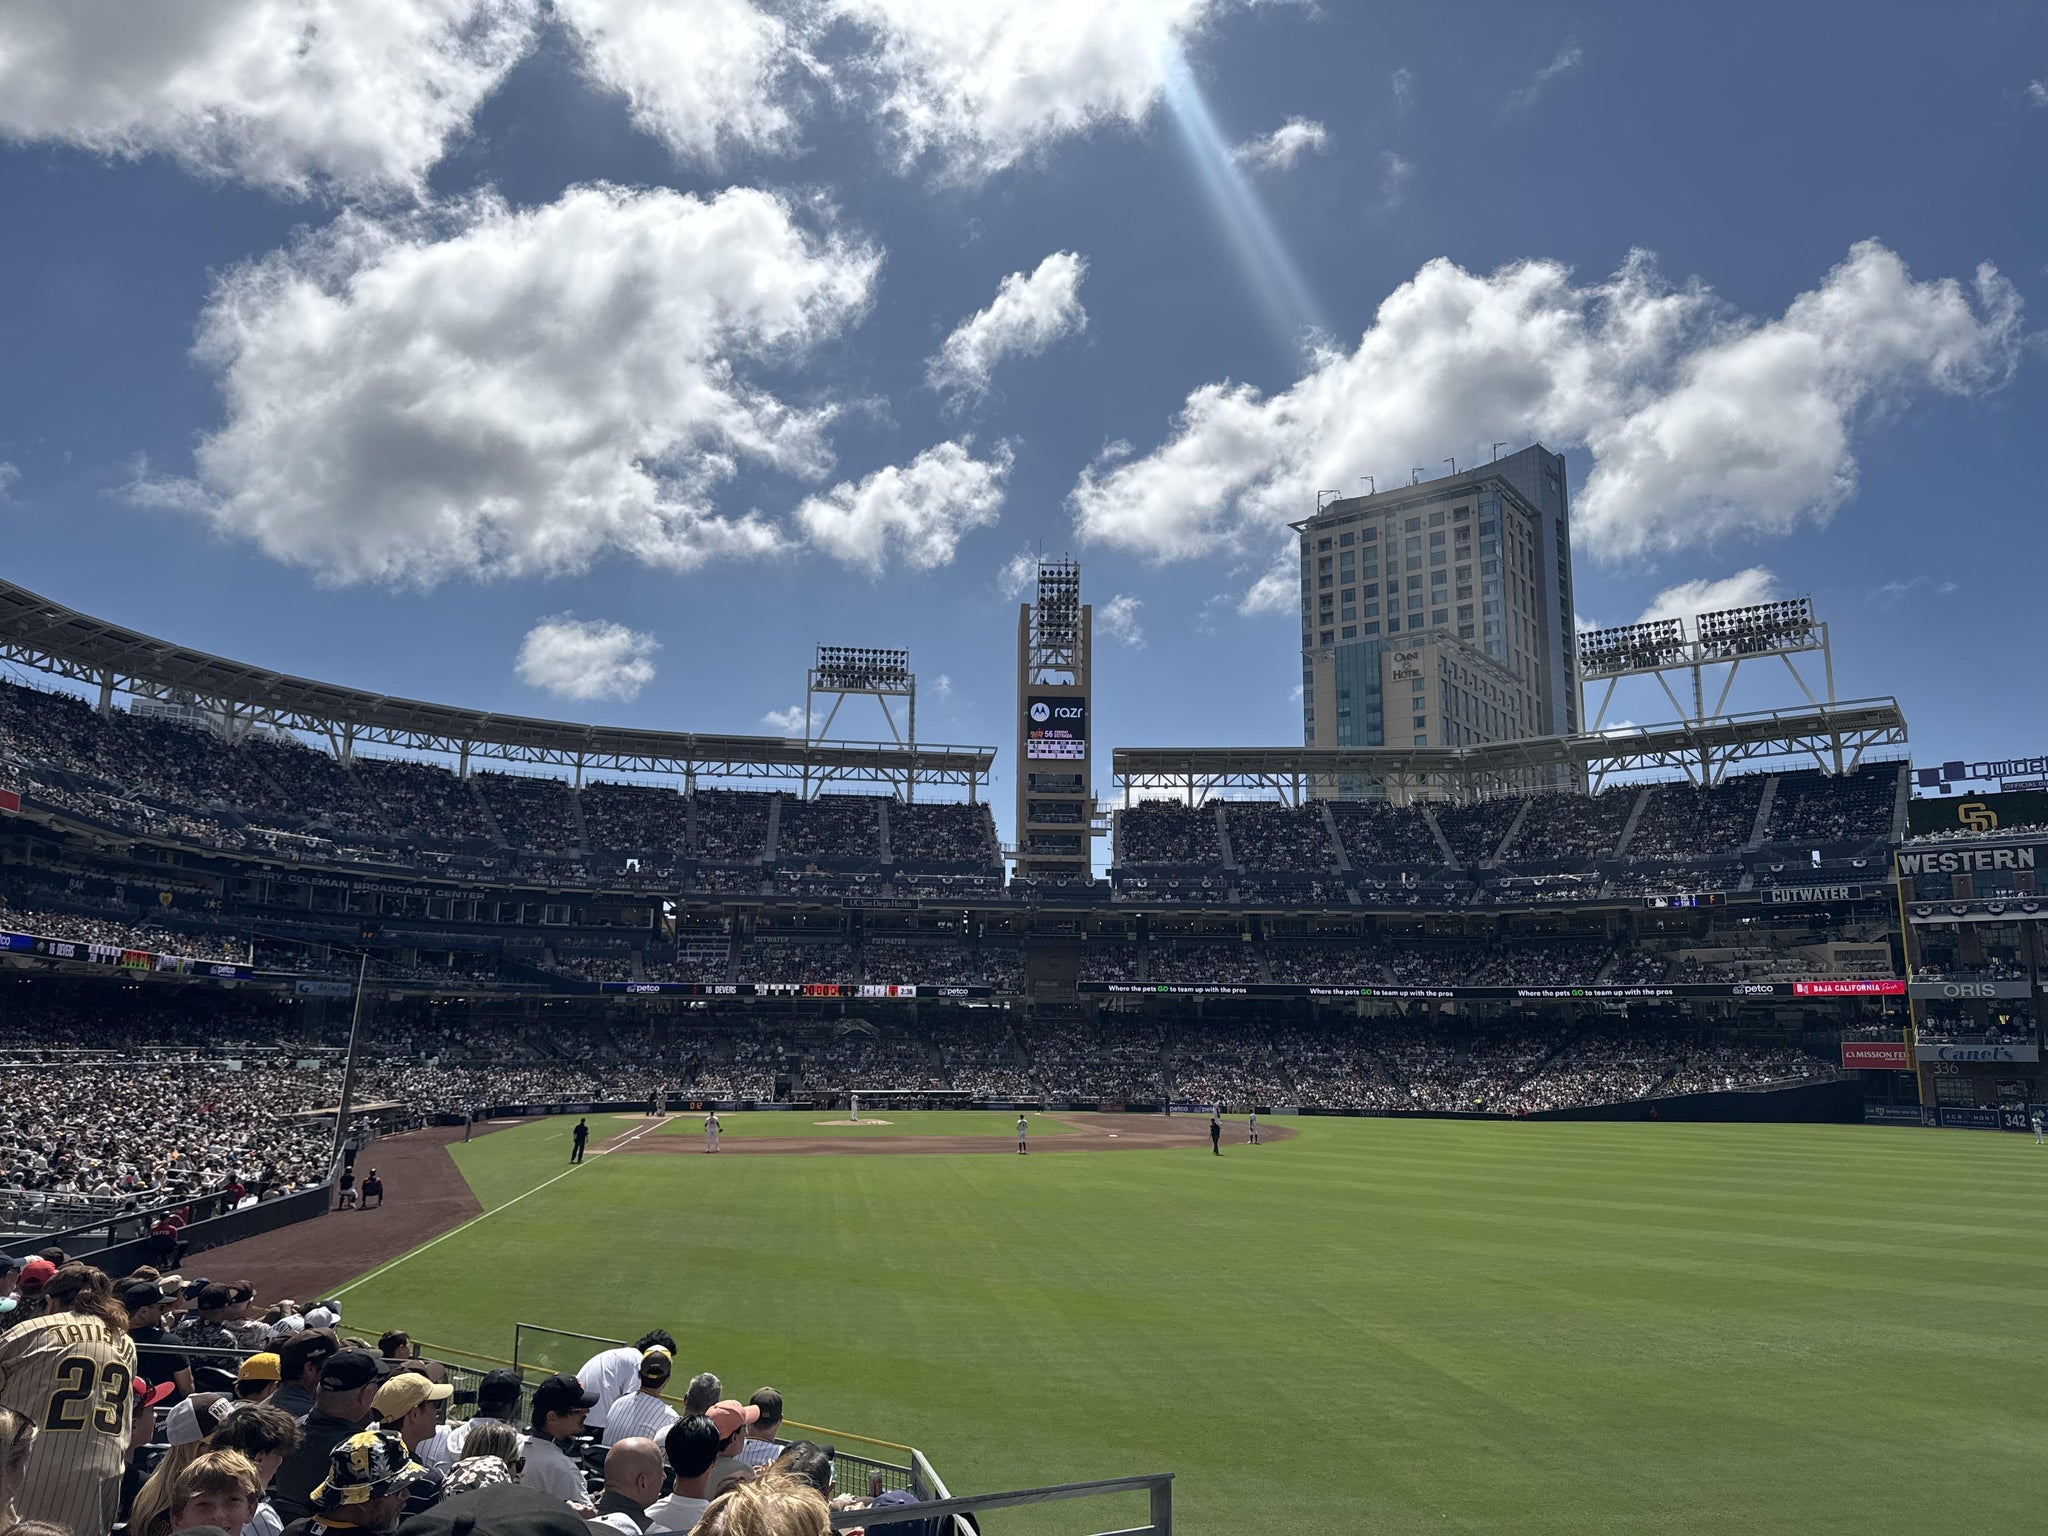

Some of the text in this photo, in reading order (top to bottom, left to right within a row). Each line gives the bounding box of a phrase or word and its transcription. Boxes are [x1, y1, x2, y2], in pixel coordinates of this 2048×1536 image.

[1394, 652, 1419, 662] OMNI
[1393, 669, 1421, 680] HOTEL
[1054, 707, 1083, 718] razr
[1044, 730, 1053, 738] 56
[2005, 781, 2037, 790] OFFICIAL
[1898, 848, 2035, 874] WESTERN
[244, 869, 485, 900] JERRY COLEMAN BROADCAST CENTER
[1772, 886, 1850, 902] CUTWATER
[217, 966, 236, 975] petco
[636, 984, 660, 993] petco
[705, 986, 736, 994] 16 DEVERS
[947, 988, 968, 996] petco
[1410, 989, 1425, 997] with
[1745, 984, 1773, 994] petco
[1834, 984, 1880, 992] CALIFORNIA
[1943, 983, 1996, 997] ORIS
[1938, 1046, 2013, 1060] Canel's
[1933, 1062, 1959, 1074] 336
[2005, 1114, 2026, 1127] 342
[50, 1323, 113, 1346] TATIS
[44, 1354, 132, 1437] 23
